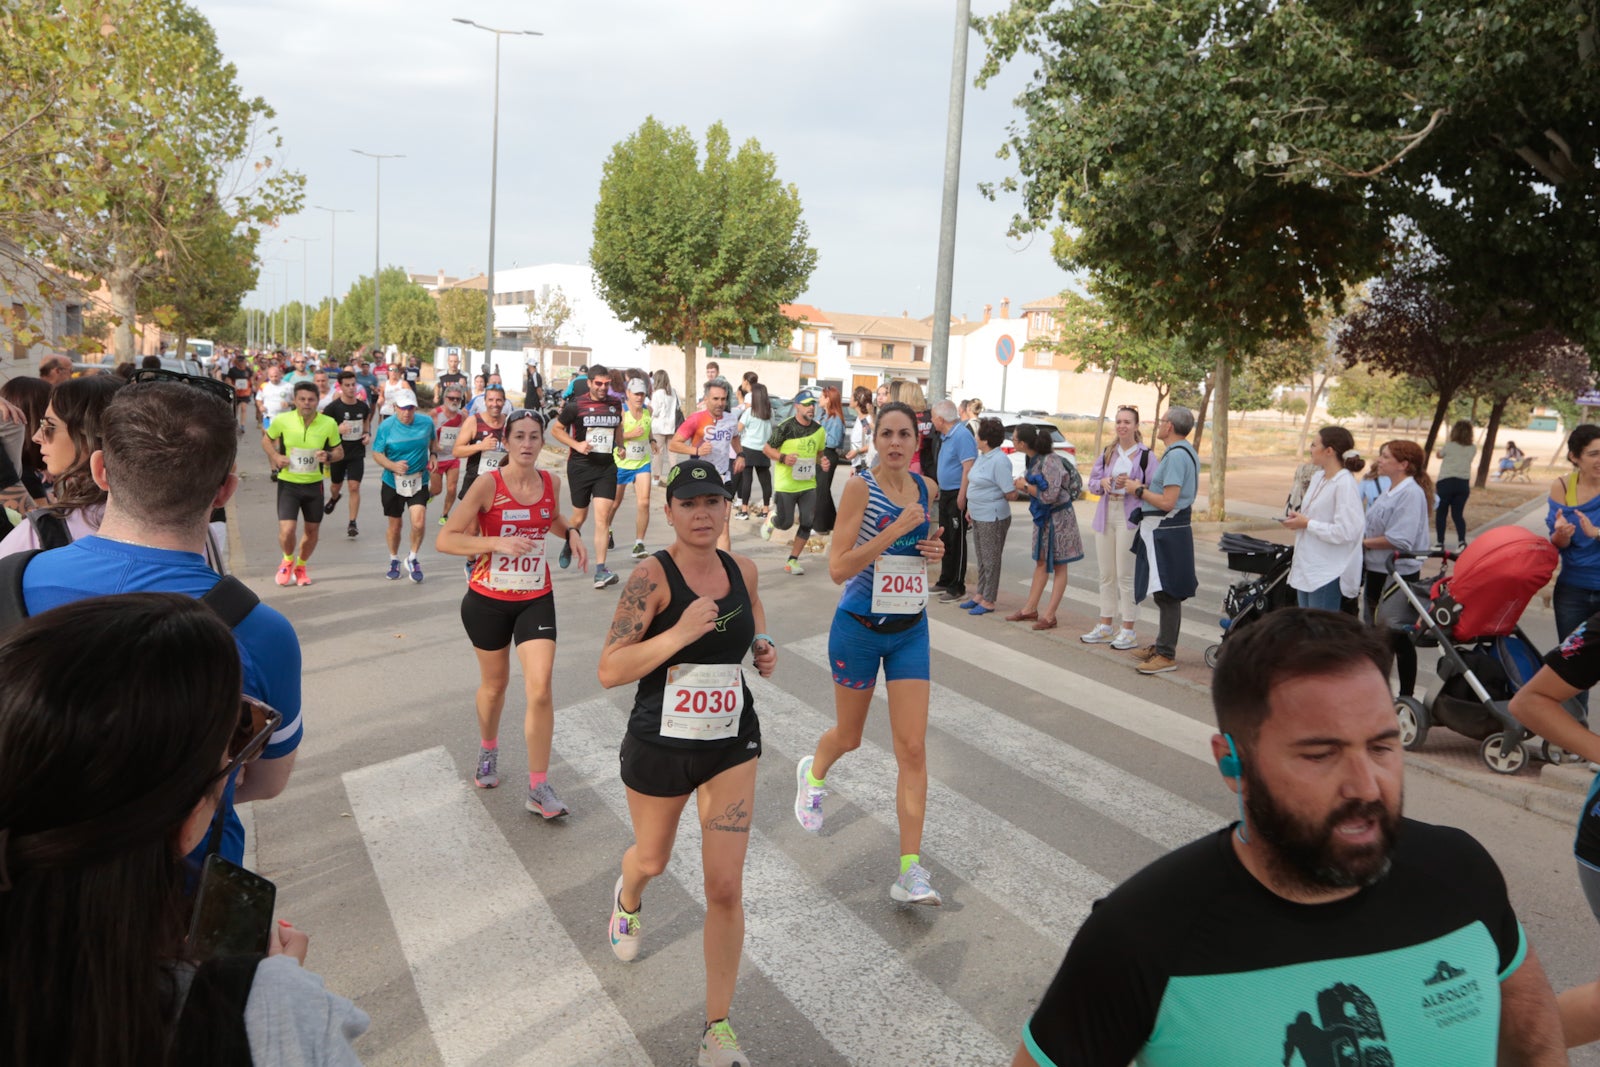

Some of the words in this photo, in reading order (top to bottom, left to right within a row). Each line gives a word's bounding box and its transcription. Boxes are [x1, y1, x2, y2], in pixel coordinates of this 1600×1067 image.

[592, 435, 608, 443] 591
[297, 456, 315, 465] 190
[798, 465, 812, 473] 417
[498, 557, 541, 572] 2107
[881, 575, 923, 594] 2043
[674, 689, 737, 714] 2030
